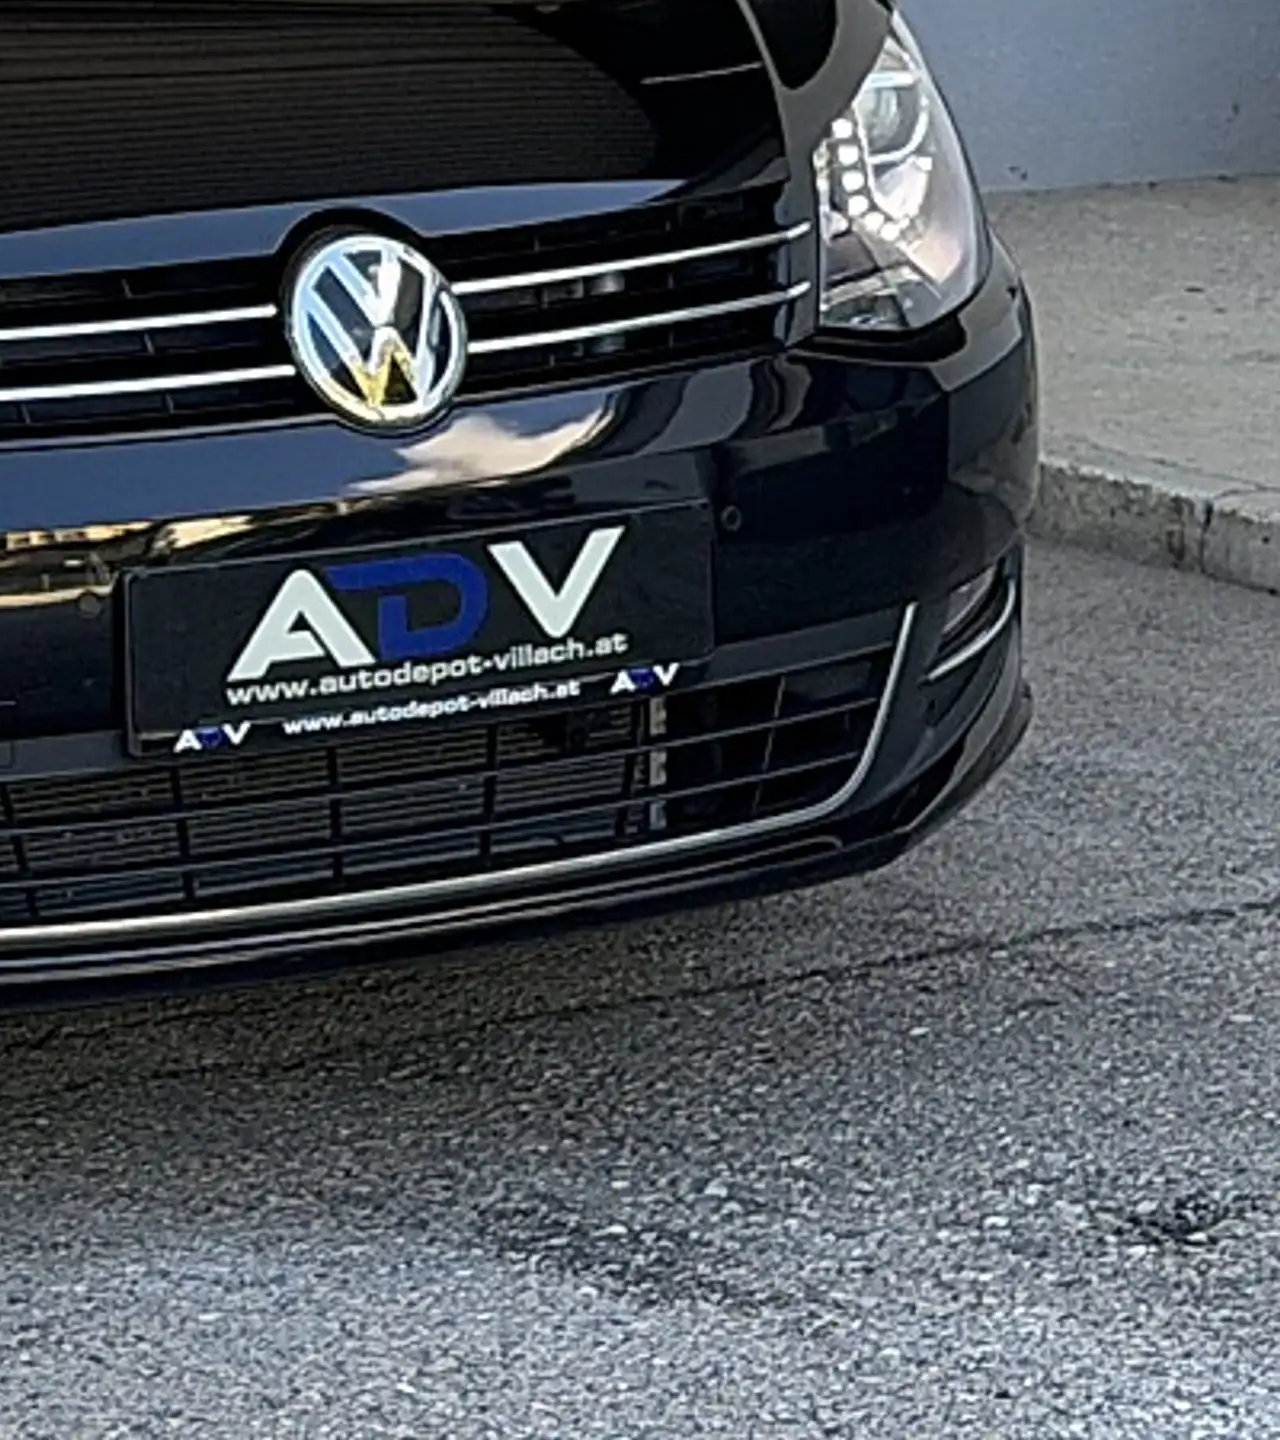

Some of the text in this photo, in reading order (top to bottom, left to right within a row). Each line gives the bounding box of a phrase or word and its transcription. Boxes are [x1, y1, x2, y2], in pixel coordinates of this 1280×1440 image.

[293, 236, 462, 421] VW
[226, 526, 625, 681] ADV
[226, 631, 627, 706] www.autodepot-villach.at
[282, 678, 580, 735] www.autodepot-villach.at
